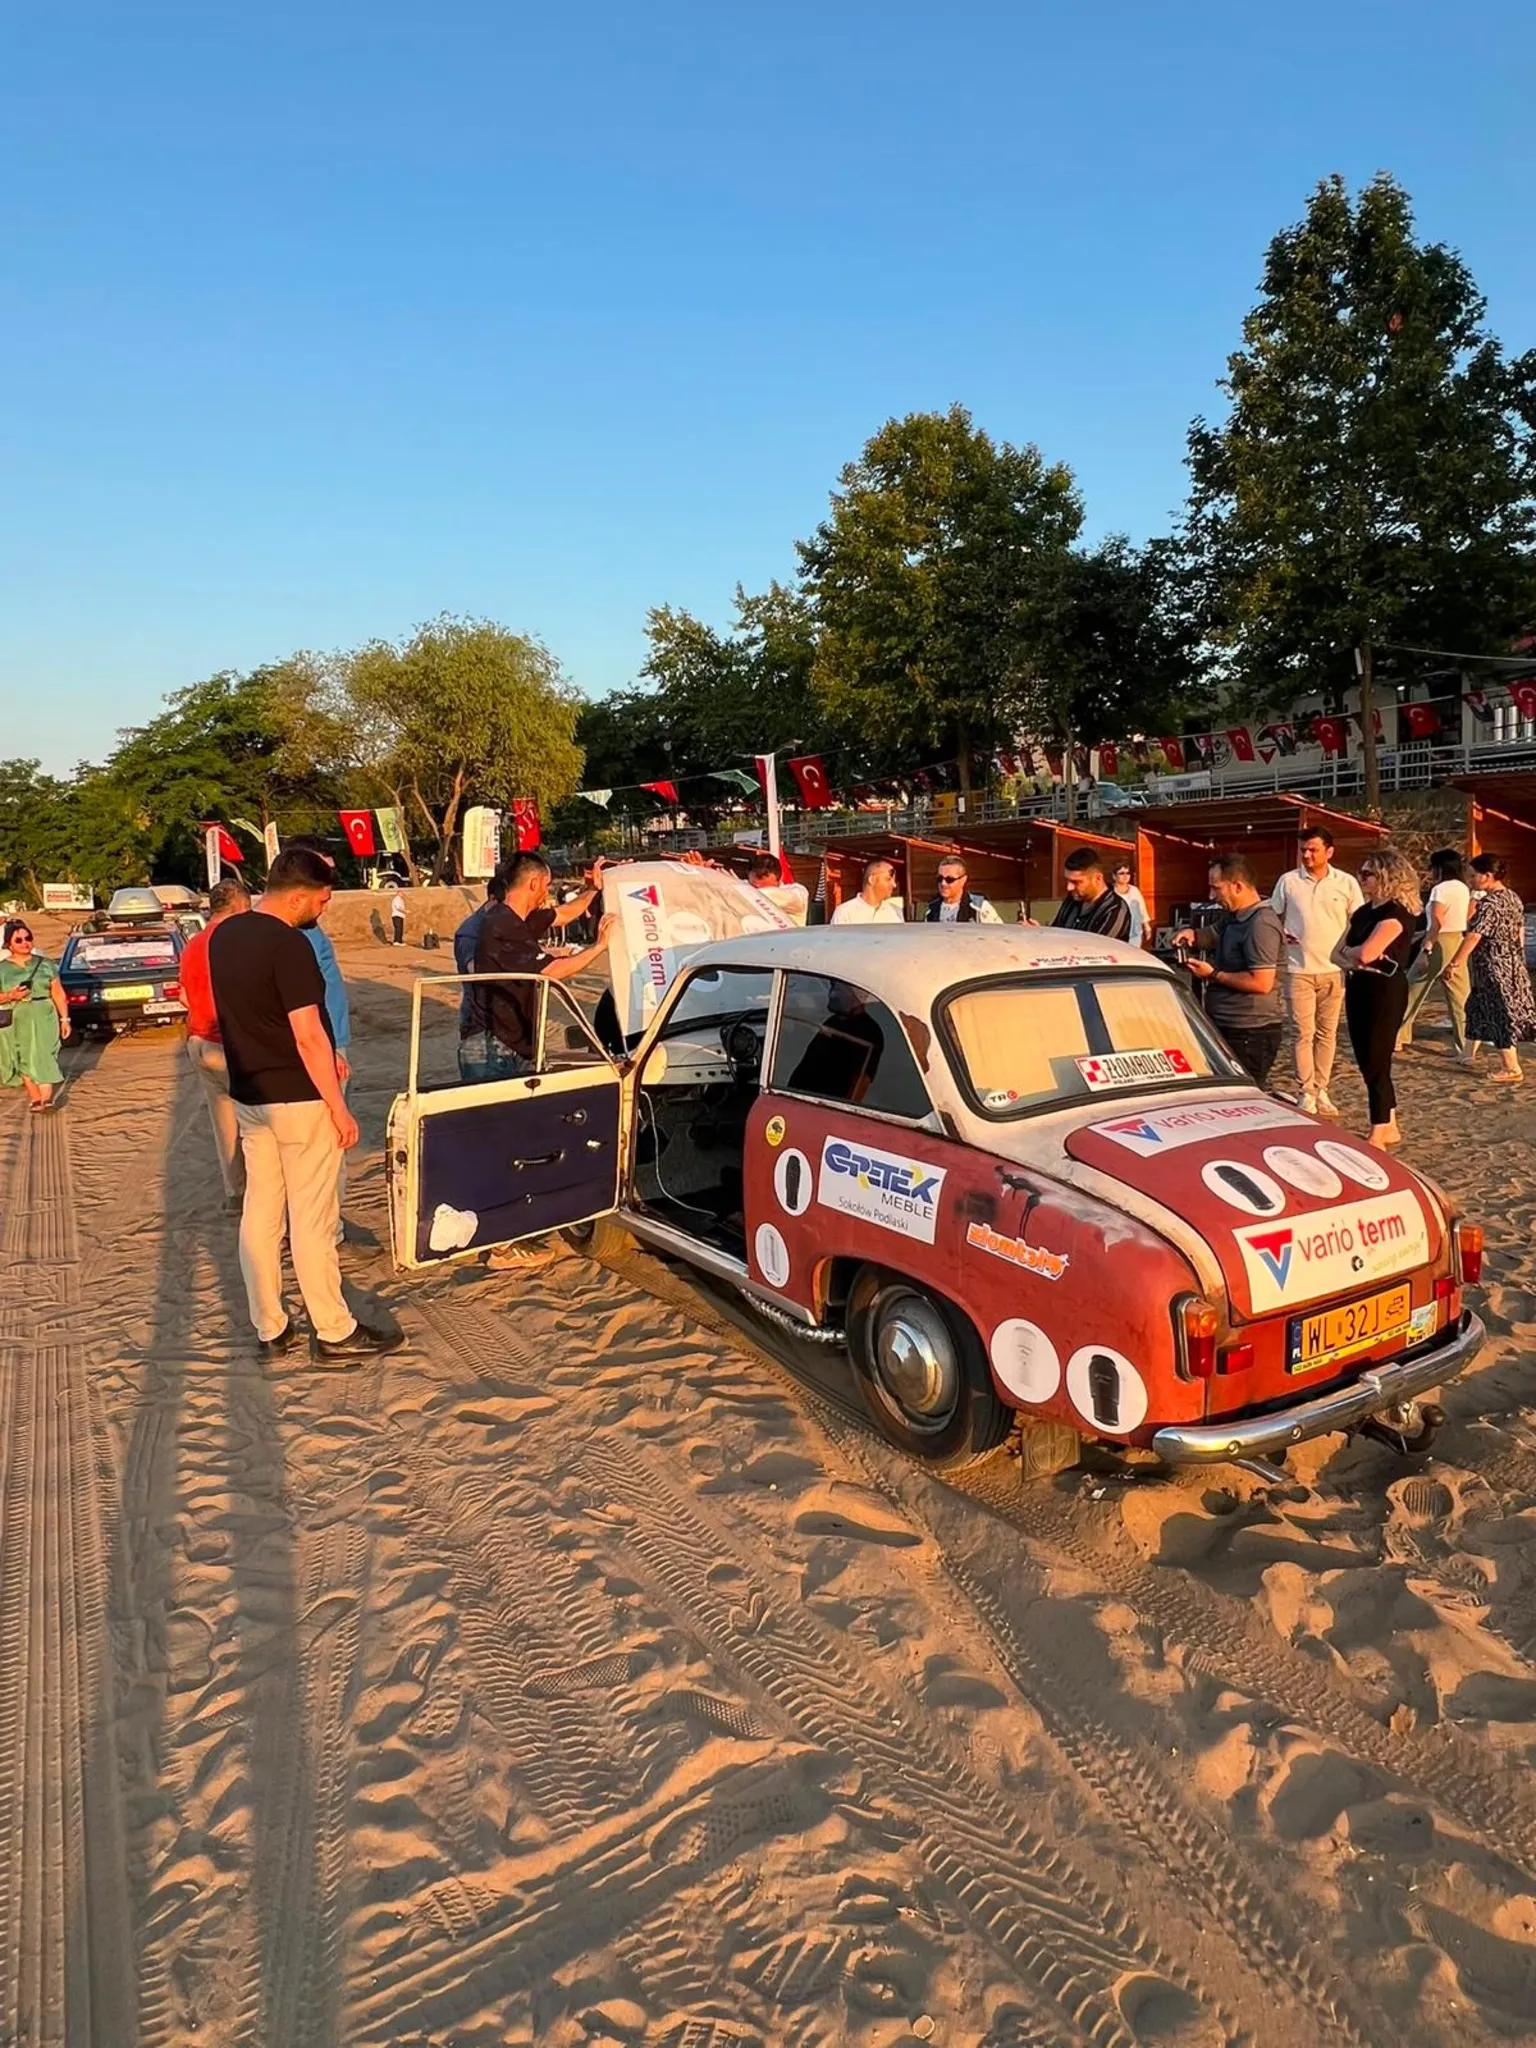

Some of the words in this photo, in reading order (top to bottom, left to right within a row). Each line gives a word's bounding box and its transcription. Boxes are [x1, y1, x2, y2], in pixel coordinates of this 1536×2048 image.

[641, 906, 661, 942] vario
[648, 947, 668, 986] term
[989, 1094, 1007, 1103] TR
[1153, 1109, 1215, 1128] vario
[1210, 1104, 1270, 1121] term
[825, 1143, 940, 1205] GRETEX
[873, 1208, 909, 1231] Podlaski
[881, 1192, 934, 1221] MEBLE
[1297, 1222, 1354, 1262] vario
[1357, 1214, 1406, 1247] term
[1308, 1316, 1335, 1356] WL
[1344, 1298, 1379, 1342] 32J
